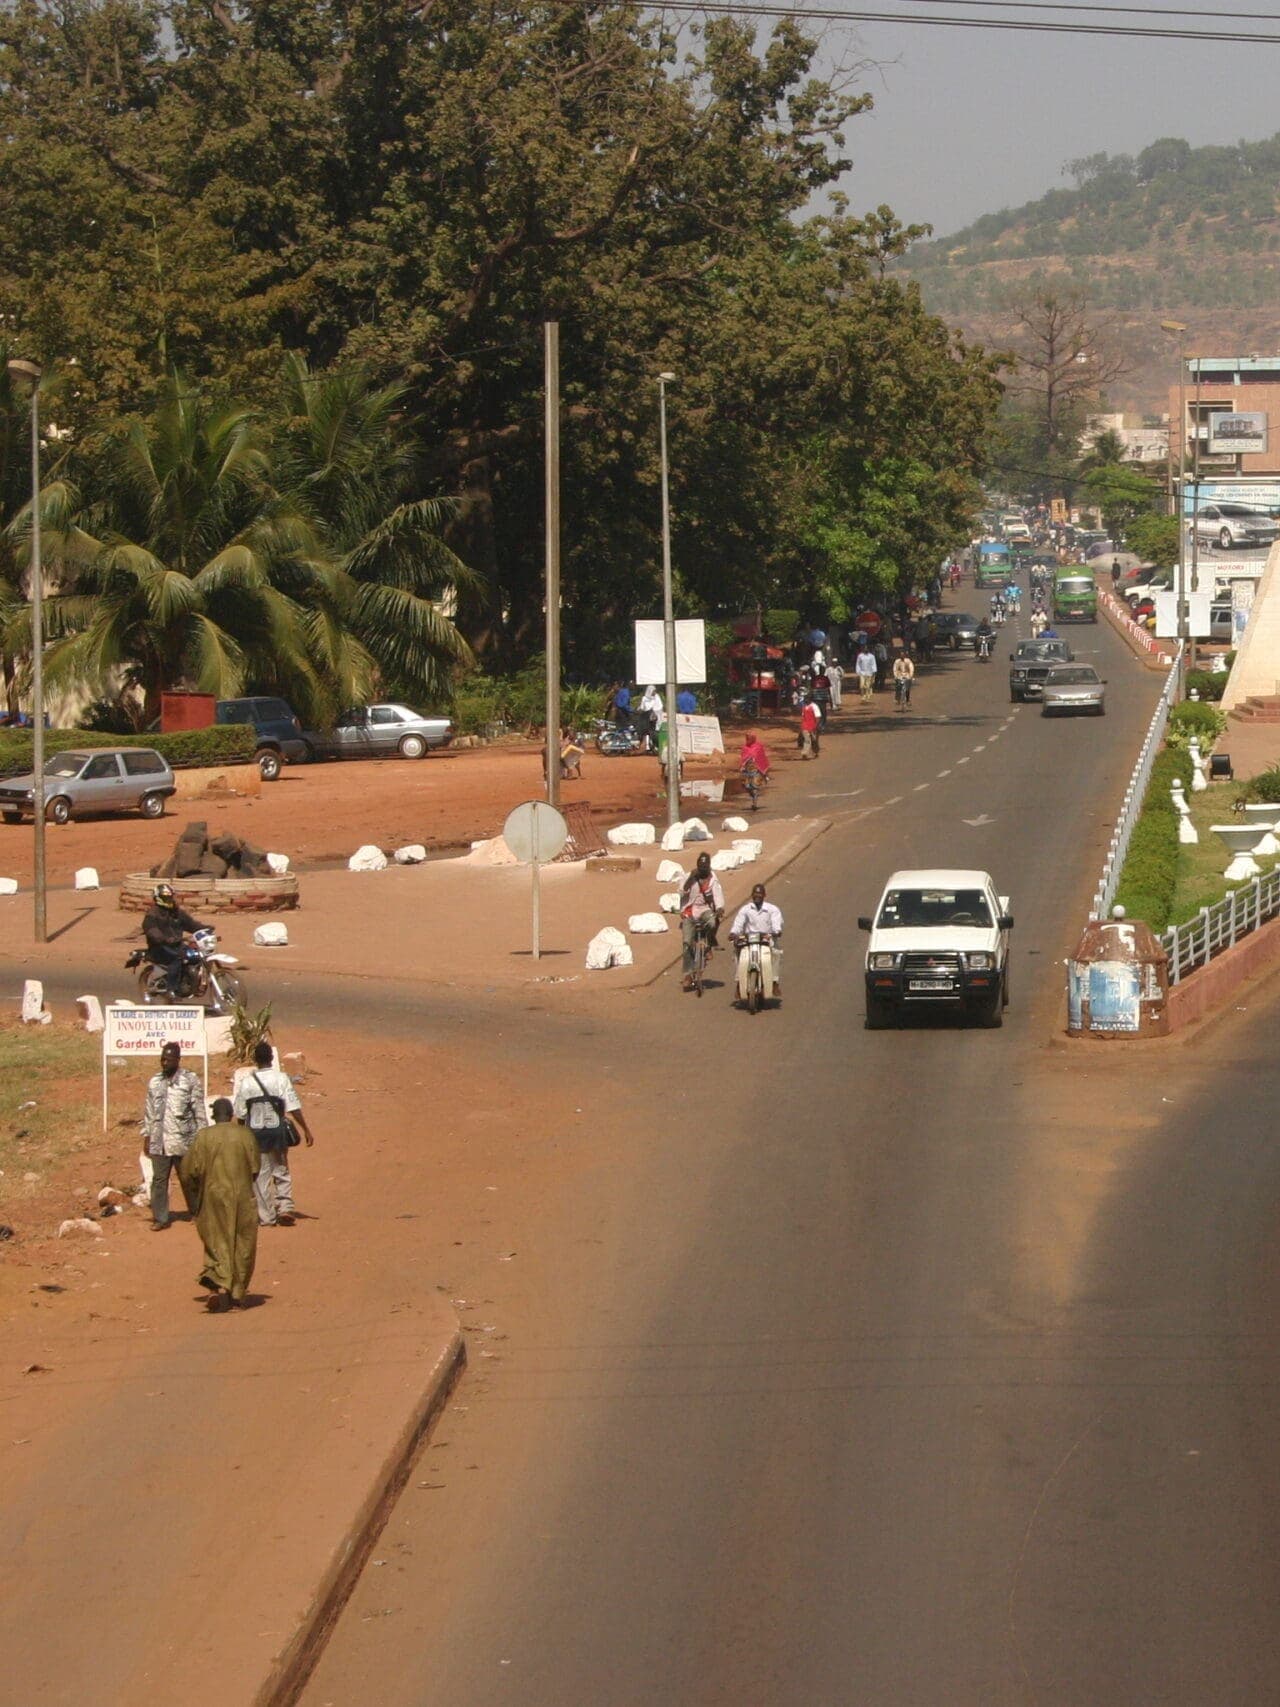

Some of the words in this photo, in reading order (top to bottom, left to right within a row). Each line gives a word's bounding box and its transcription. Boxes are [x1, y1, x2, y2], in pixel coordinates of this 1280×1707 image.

[169, 1021, 192, 1030] VILLE
[116, 1039, 156, 1049] Garden
[159, 1039, 196, 1049] Cter
